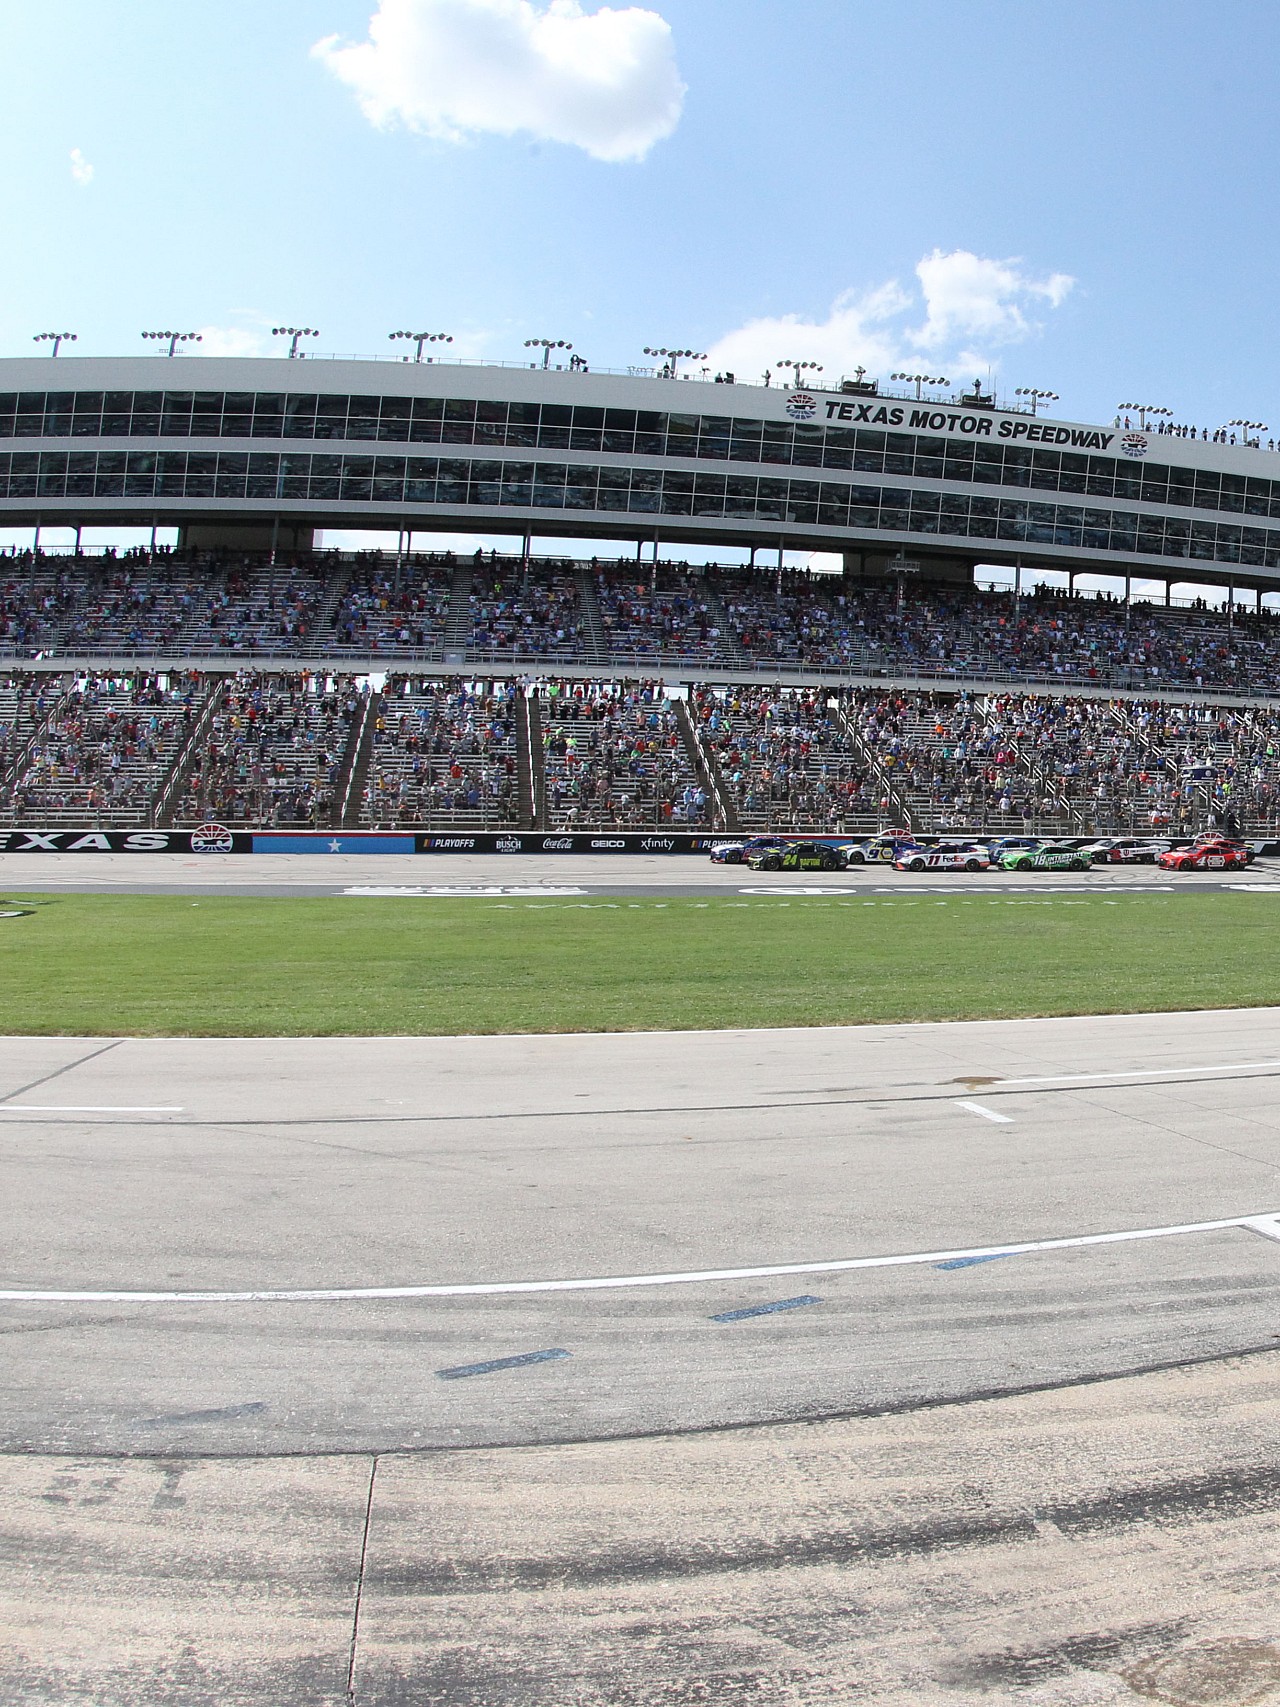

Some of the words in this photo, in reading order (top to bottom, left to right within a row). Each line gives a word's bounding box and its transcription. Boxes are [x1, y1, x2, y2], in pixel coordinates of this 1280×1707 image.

[825, 401, 904, 426] TEXAS
[908, 410, 991, 436] MOTOR
[997, 420, 1115, 450] SPEEDWAY
[0, 833, 170, 850] XAS
[434, 839, 475, 848] PLAYOFFS
[496, 840, 521, 849] BUSCH
[542, 838, 574, 849] Coca-Cola
[591, 840, 625, 848] GEICO
[641, 838, 675, 850] xfinity
[868, 848, 880, 859] 9
[943, 854, 966, 863] FedEx
[783, 854, 798, 866] 24
[929, 855, 941, 866] 11
[1034, 854, 1047, 866] 18
[1196, 856, 1207, 867] 4
